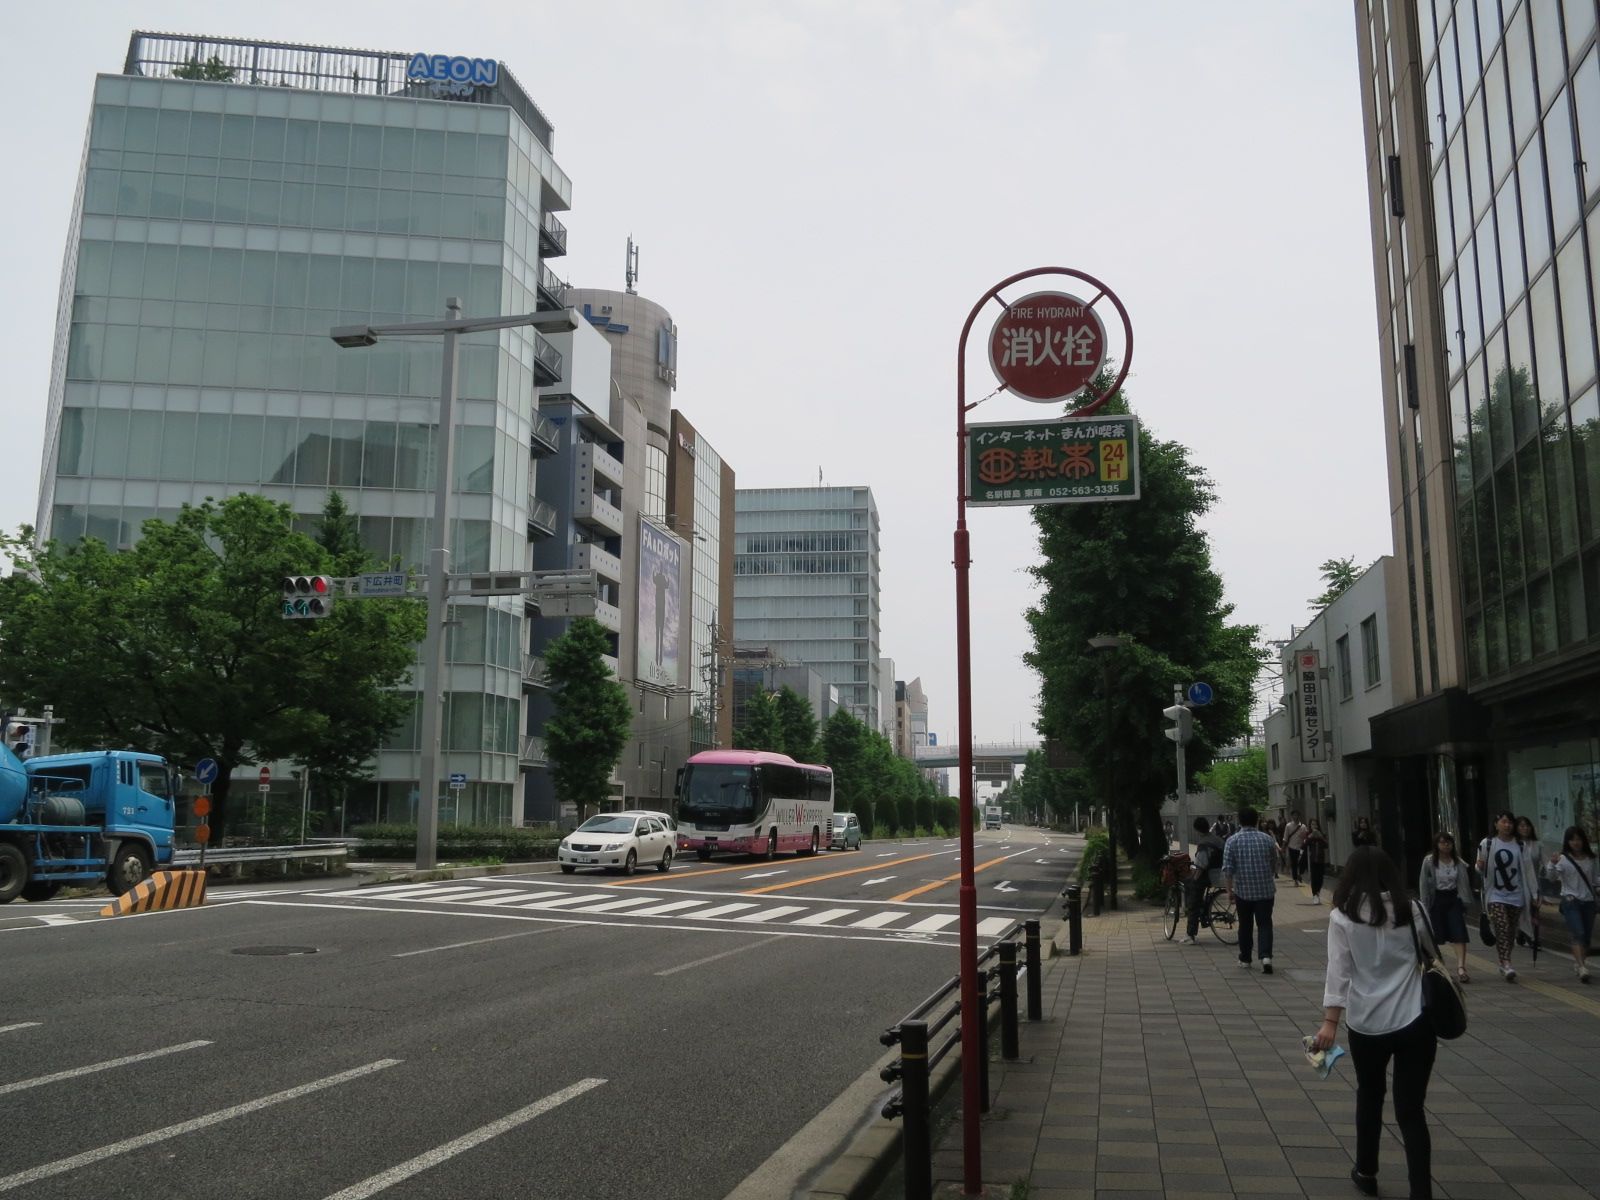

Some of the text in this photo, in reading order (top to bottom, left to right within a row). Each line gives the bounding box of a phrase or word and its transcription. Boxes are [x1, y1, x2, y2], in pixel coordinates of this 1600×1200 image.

[407, 53, 497, 85] AEON
[1010, 306, 1086, 319] FIRE HYDRANT
[1001, 325, 1097, 367] 消火栓
[1103, 443, 1125, 462] 24
[1107, 463, 1121, 479] H
[363, 575, 403, 587] 下広井町
[776, 808, 795, 824] WILLER
[804, 808, 823, 824] EXPRESS
